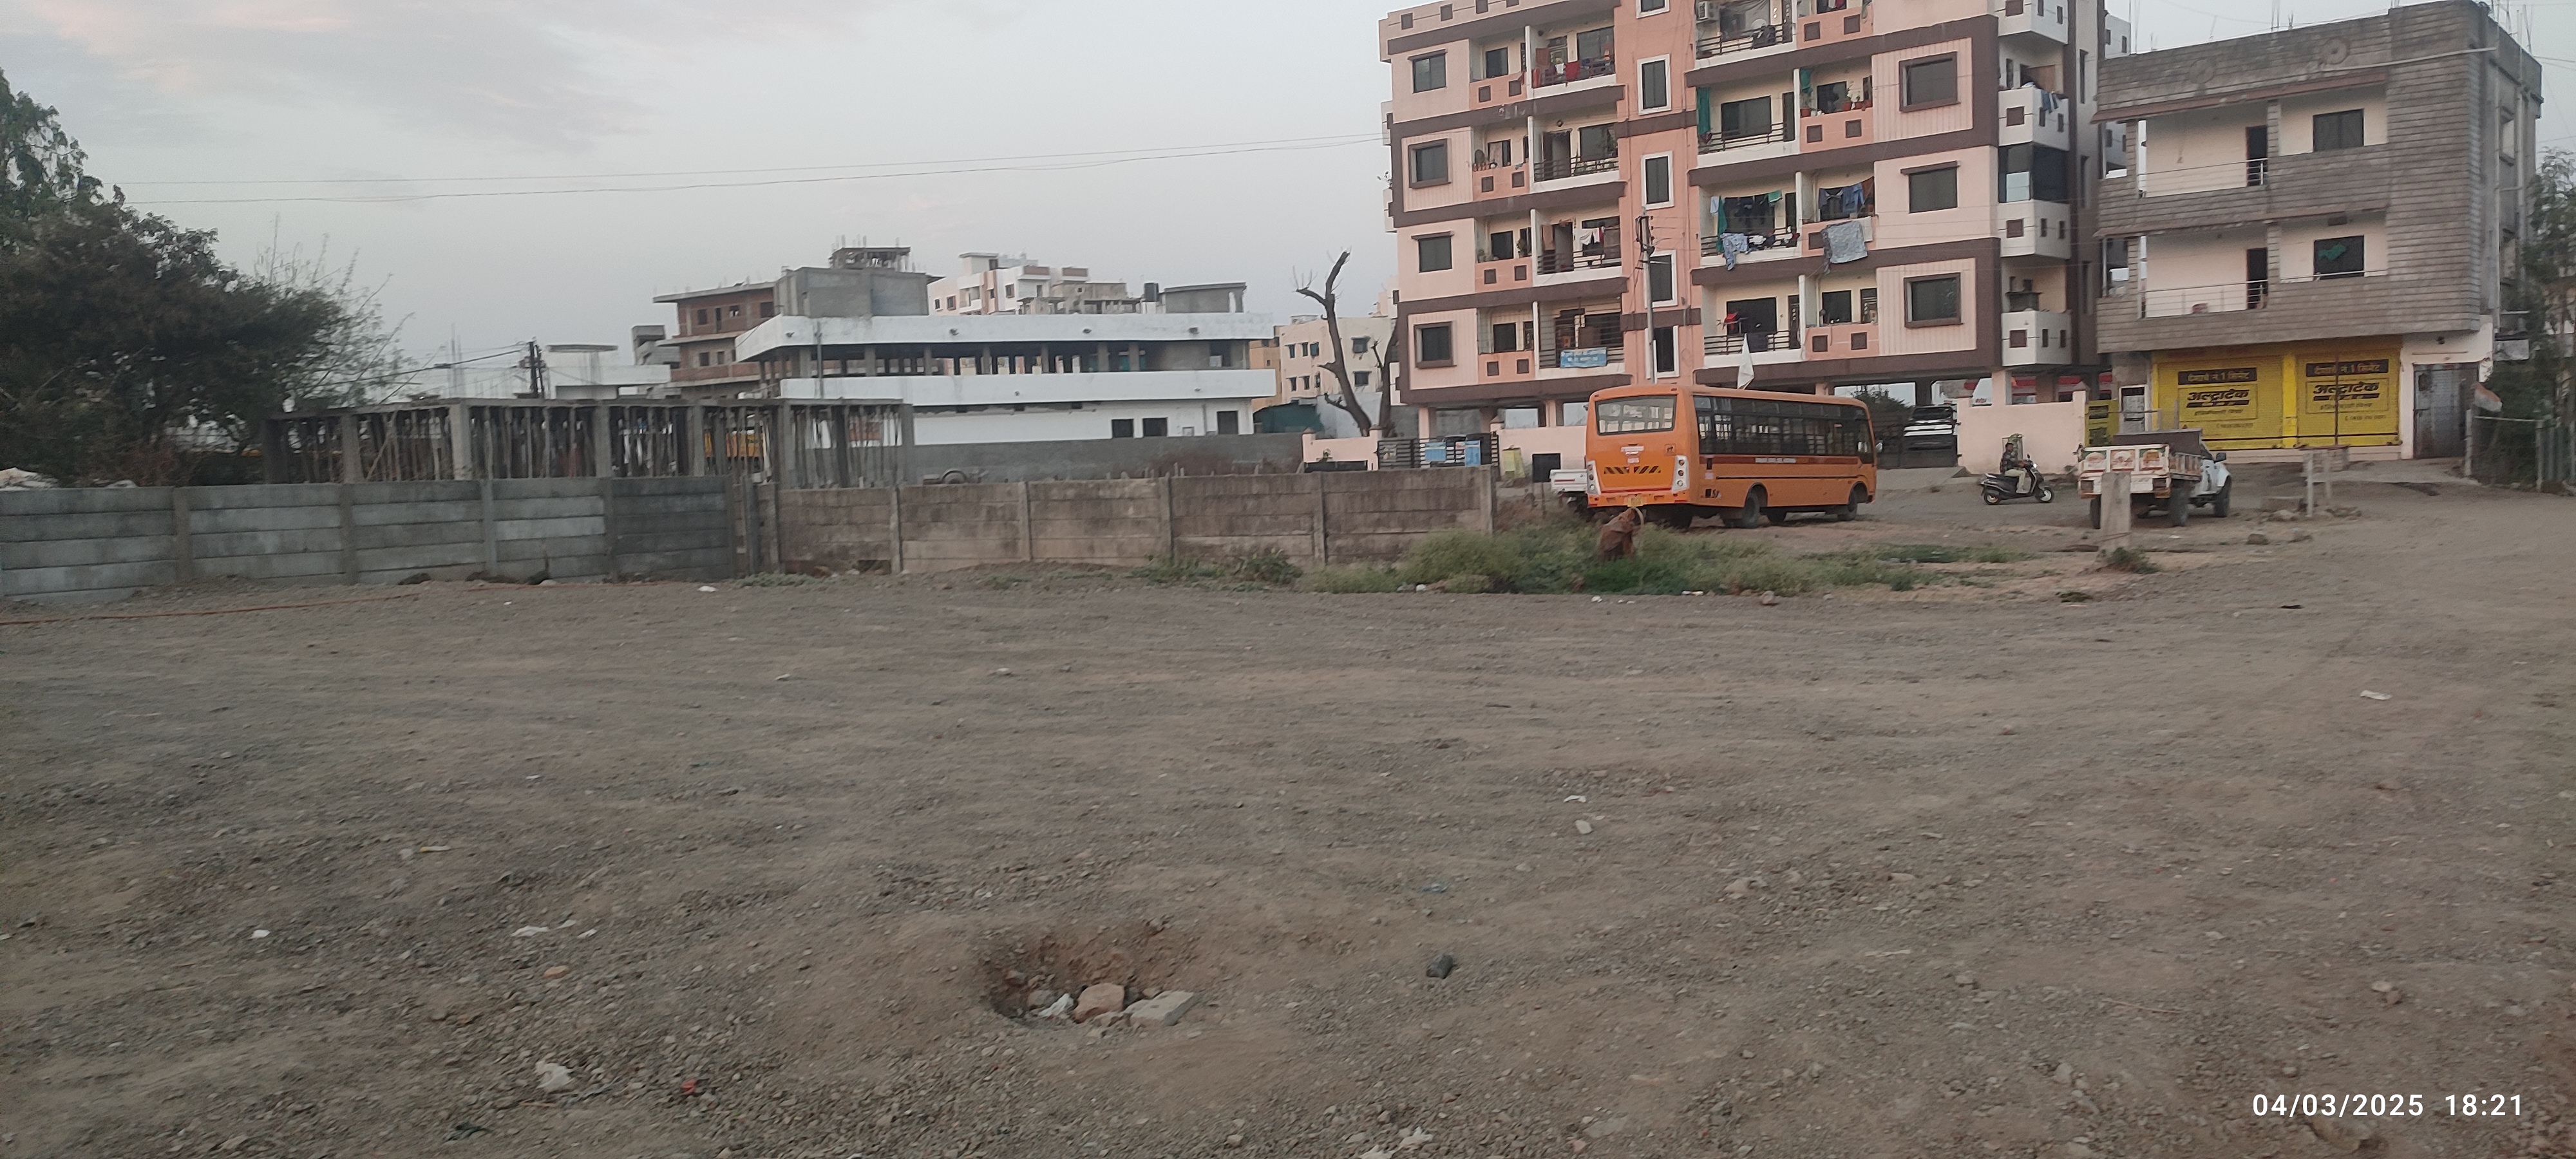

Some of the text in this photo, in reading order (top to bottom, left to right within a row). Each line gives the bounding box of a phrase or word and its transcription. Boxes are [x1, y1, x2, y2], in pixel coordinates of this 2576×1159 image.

[2221, 372, 2226, 380] 1
[2313, 381, 2380, 394] अल्ट्राटेक
[2187, 388, 2249, 401] अल्ट्राटेक
